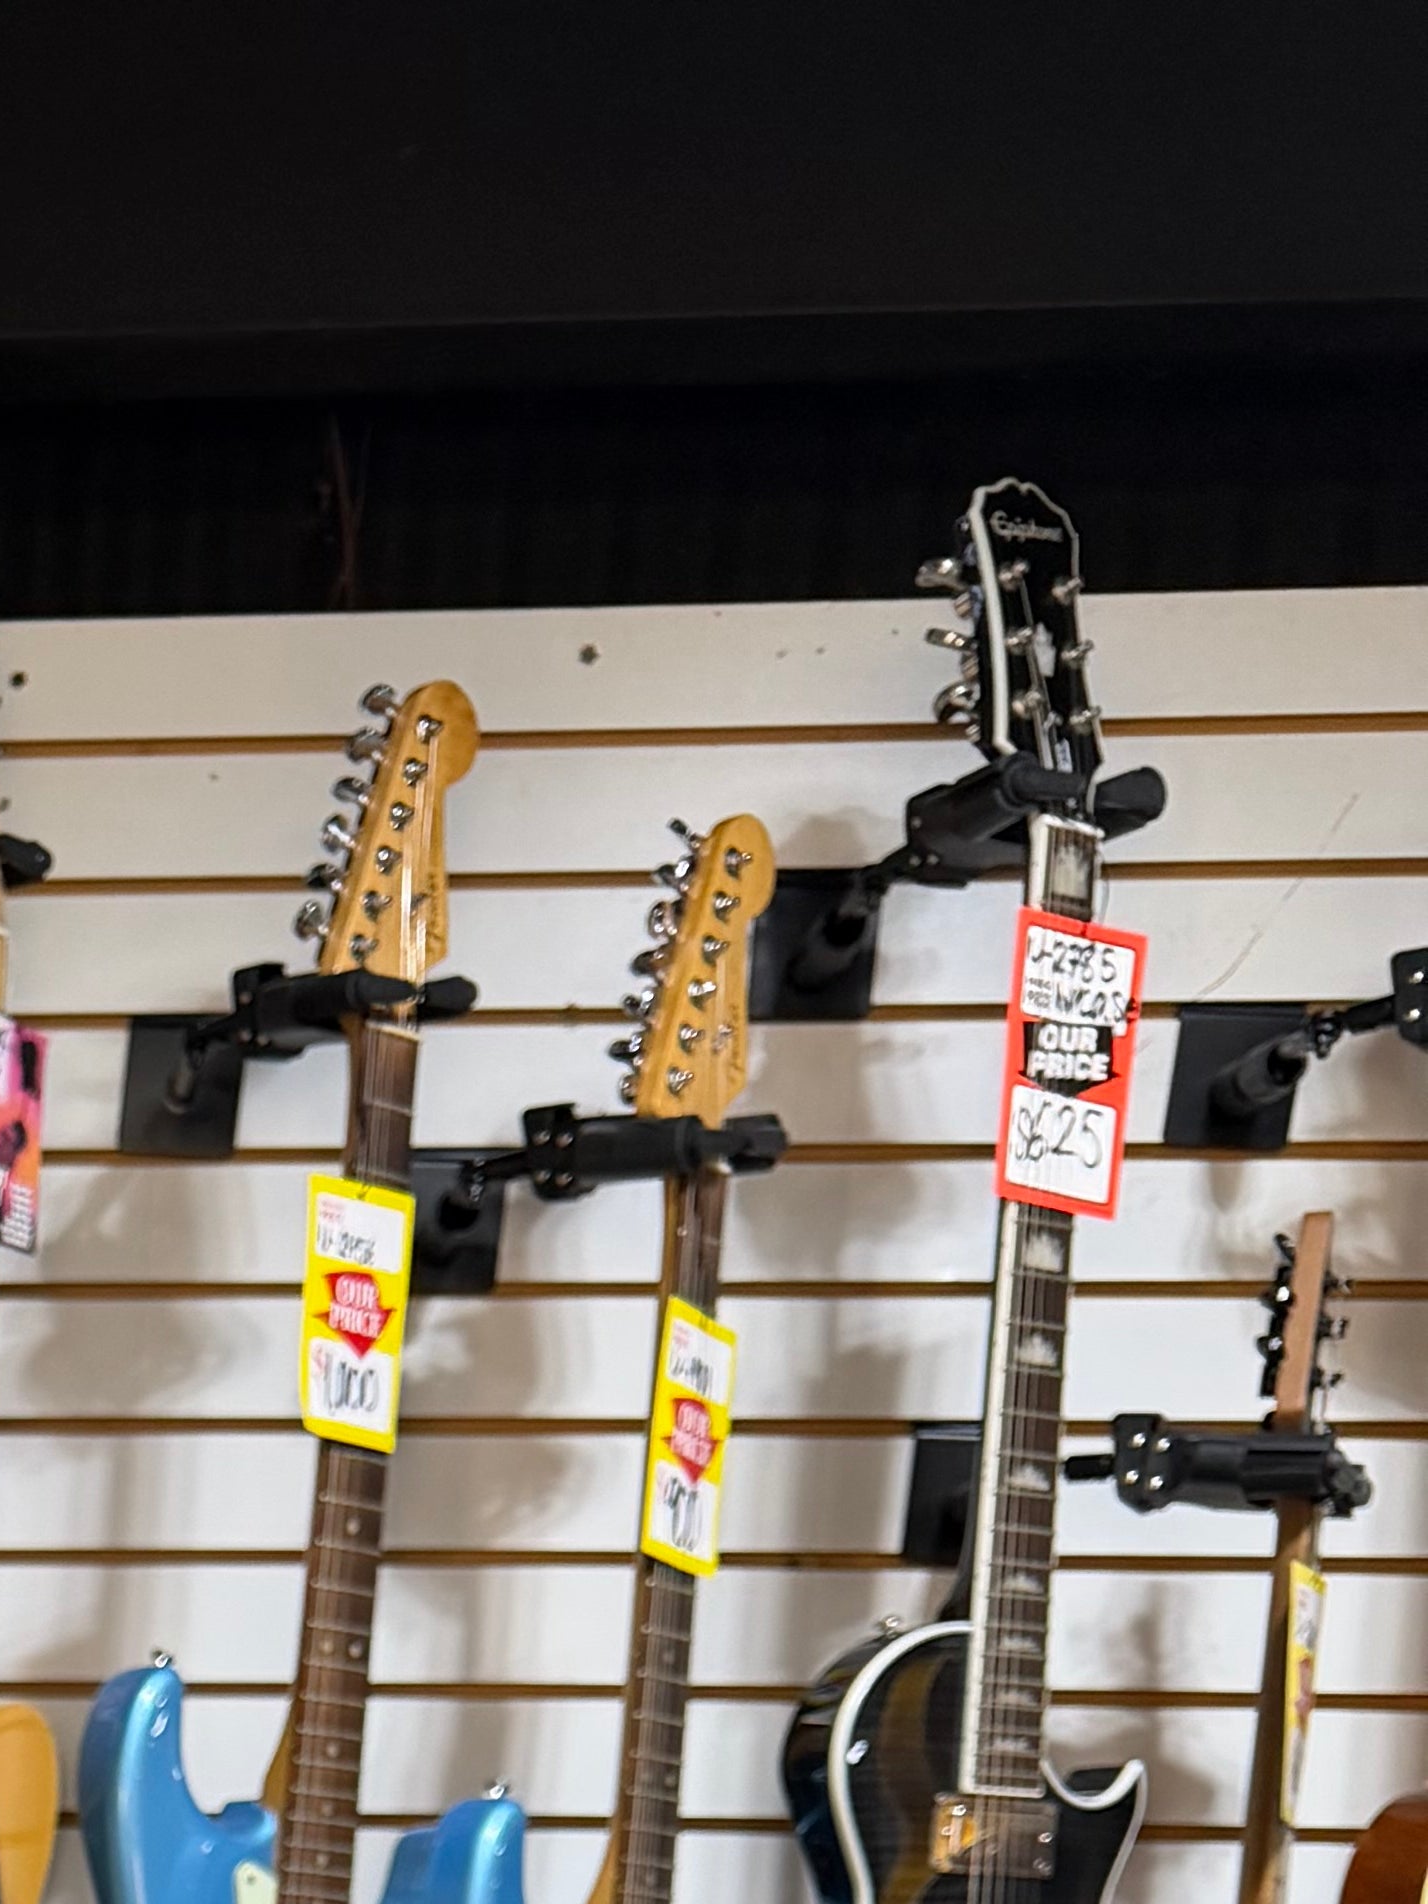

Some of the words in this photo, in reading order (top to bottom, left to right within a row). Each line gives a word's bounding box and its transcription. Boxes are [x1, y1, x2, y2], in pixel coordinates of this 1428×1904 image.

[1037, 1023, 1100, 1053] OUR
[1026, 1050, 1110, 1081] PRICE
[335, 1275, 380, 1309] OUR
[329, 1302, 387, 1340] PRICE
